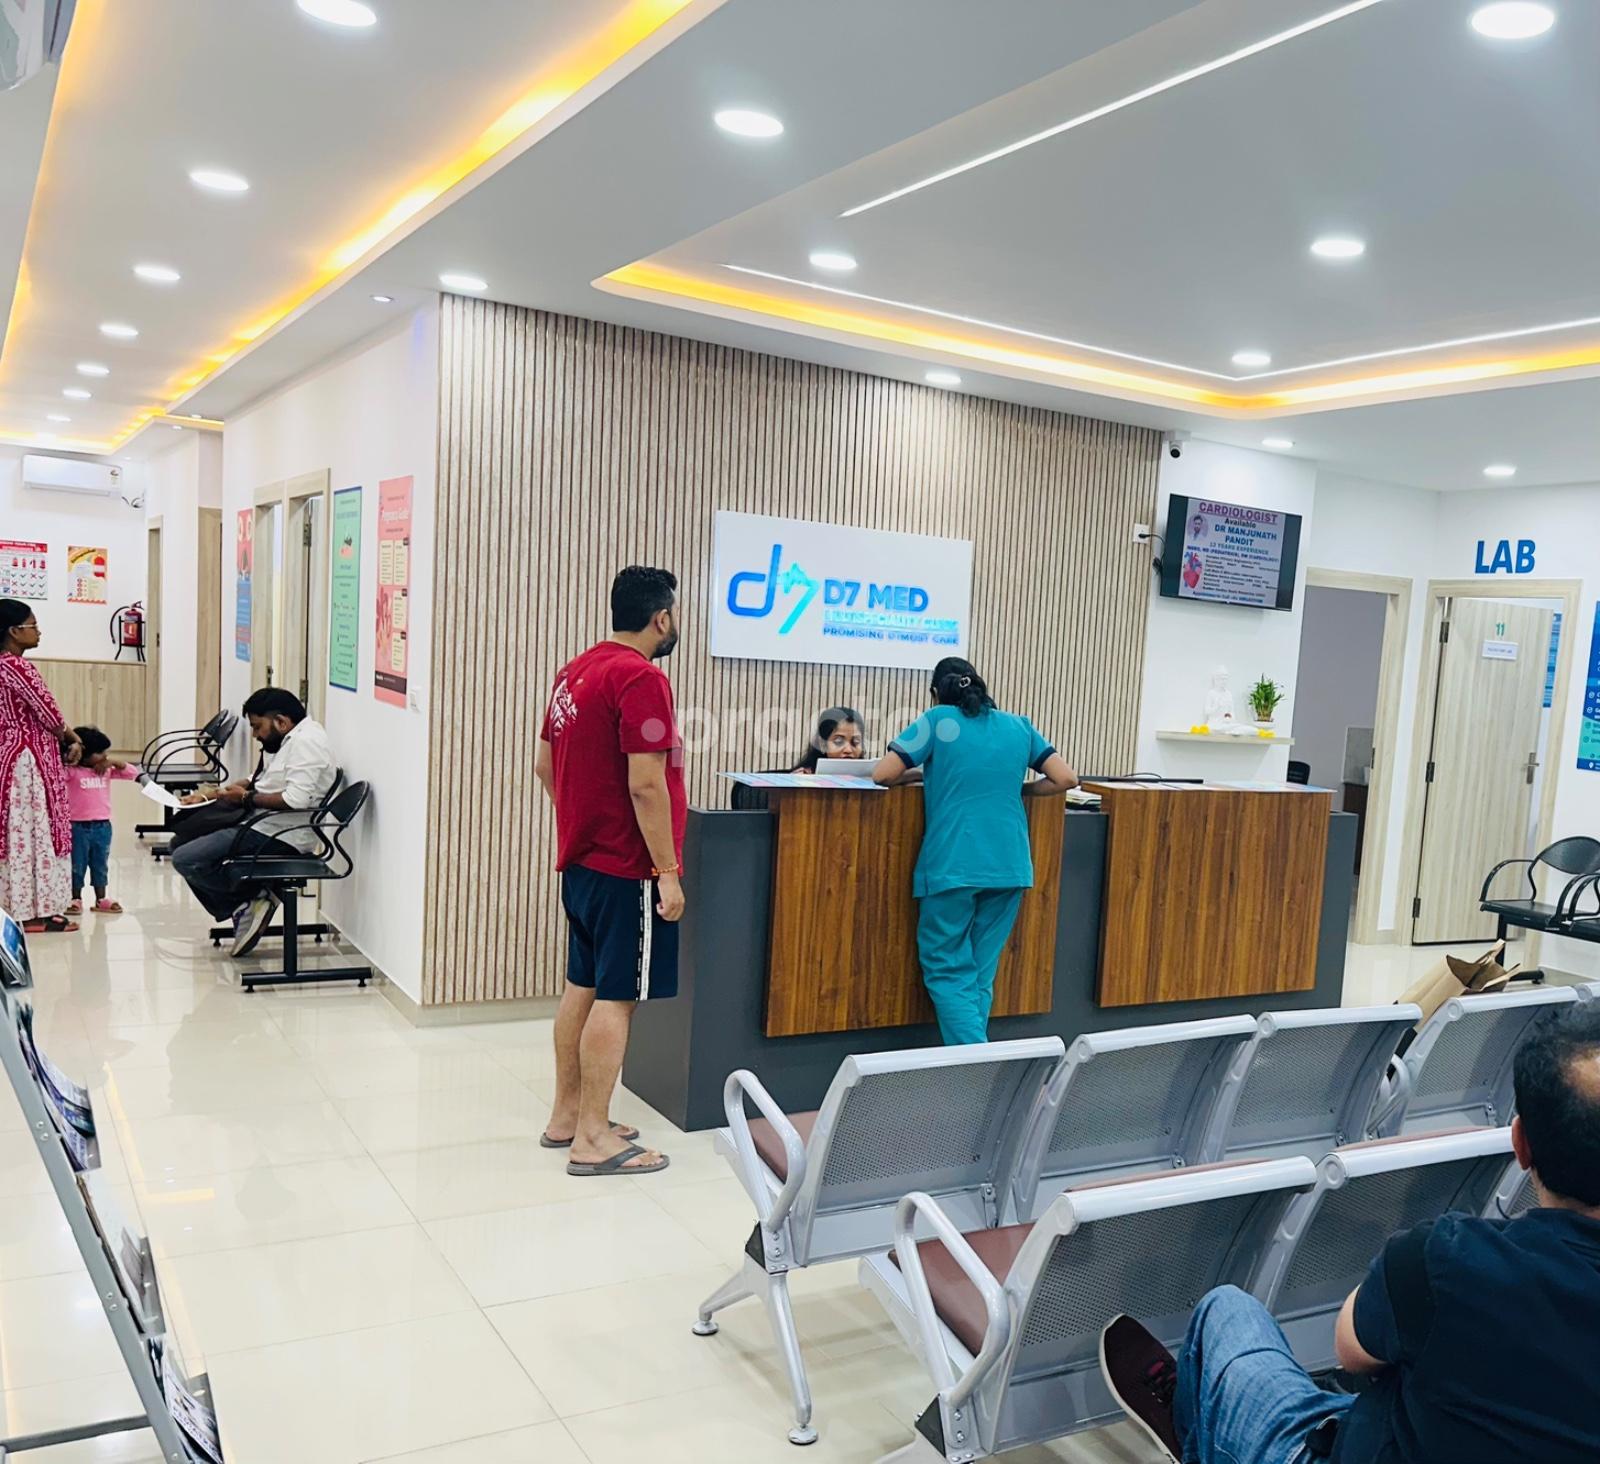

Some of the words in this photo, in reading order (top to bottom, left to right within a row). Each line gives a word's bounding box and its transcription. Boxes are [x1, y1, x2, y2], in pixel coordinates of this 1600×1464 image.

[1199, 501, 1279, 523] CARDIOLOGIST
[1224, 518, 1257, 529] Available
[1215, 523, 1226, 533] DR
[1227, 526, 1278, 541] MANJUNATH
[1225, 535, 1255, 546] PANDIT
[1475, 539, 1536, 574] LAB
[823, 579, 861, 606] D7
[868, 583, 929, 613] MED
[823, 626, 884, 640] PROMISING
[1495, 622, 1506, 637] 11
[80, 777, 107, 789] SMILE
